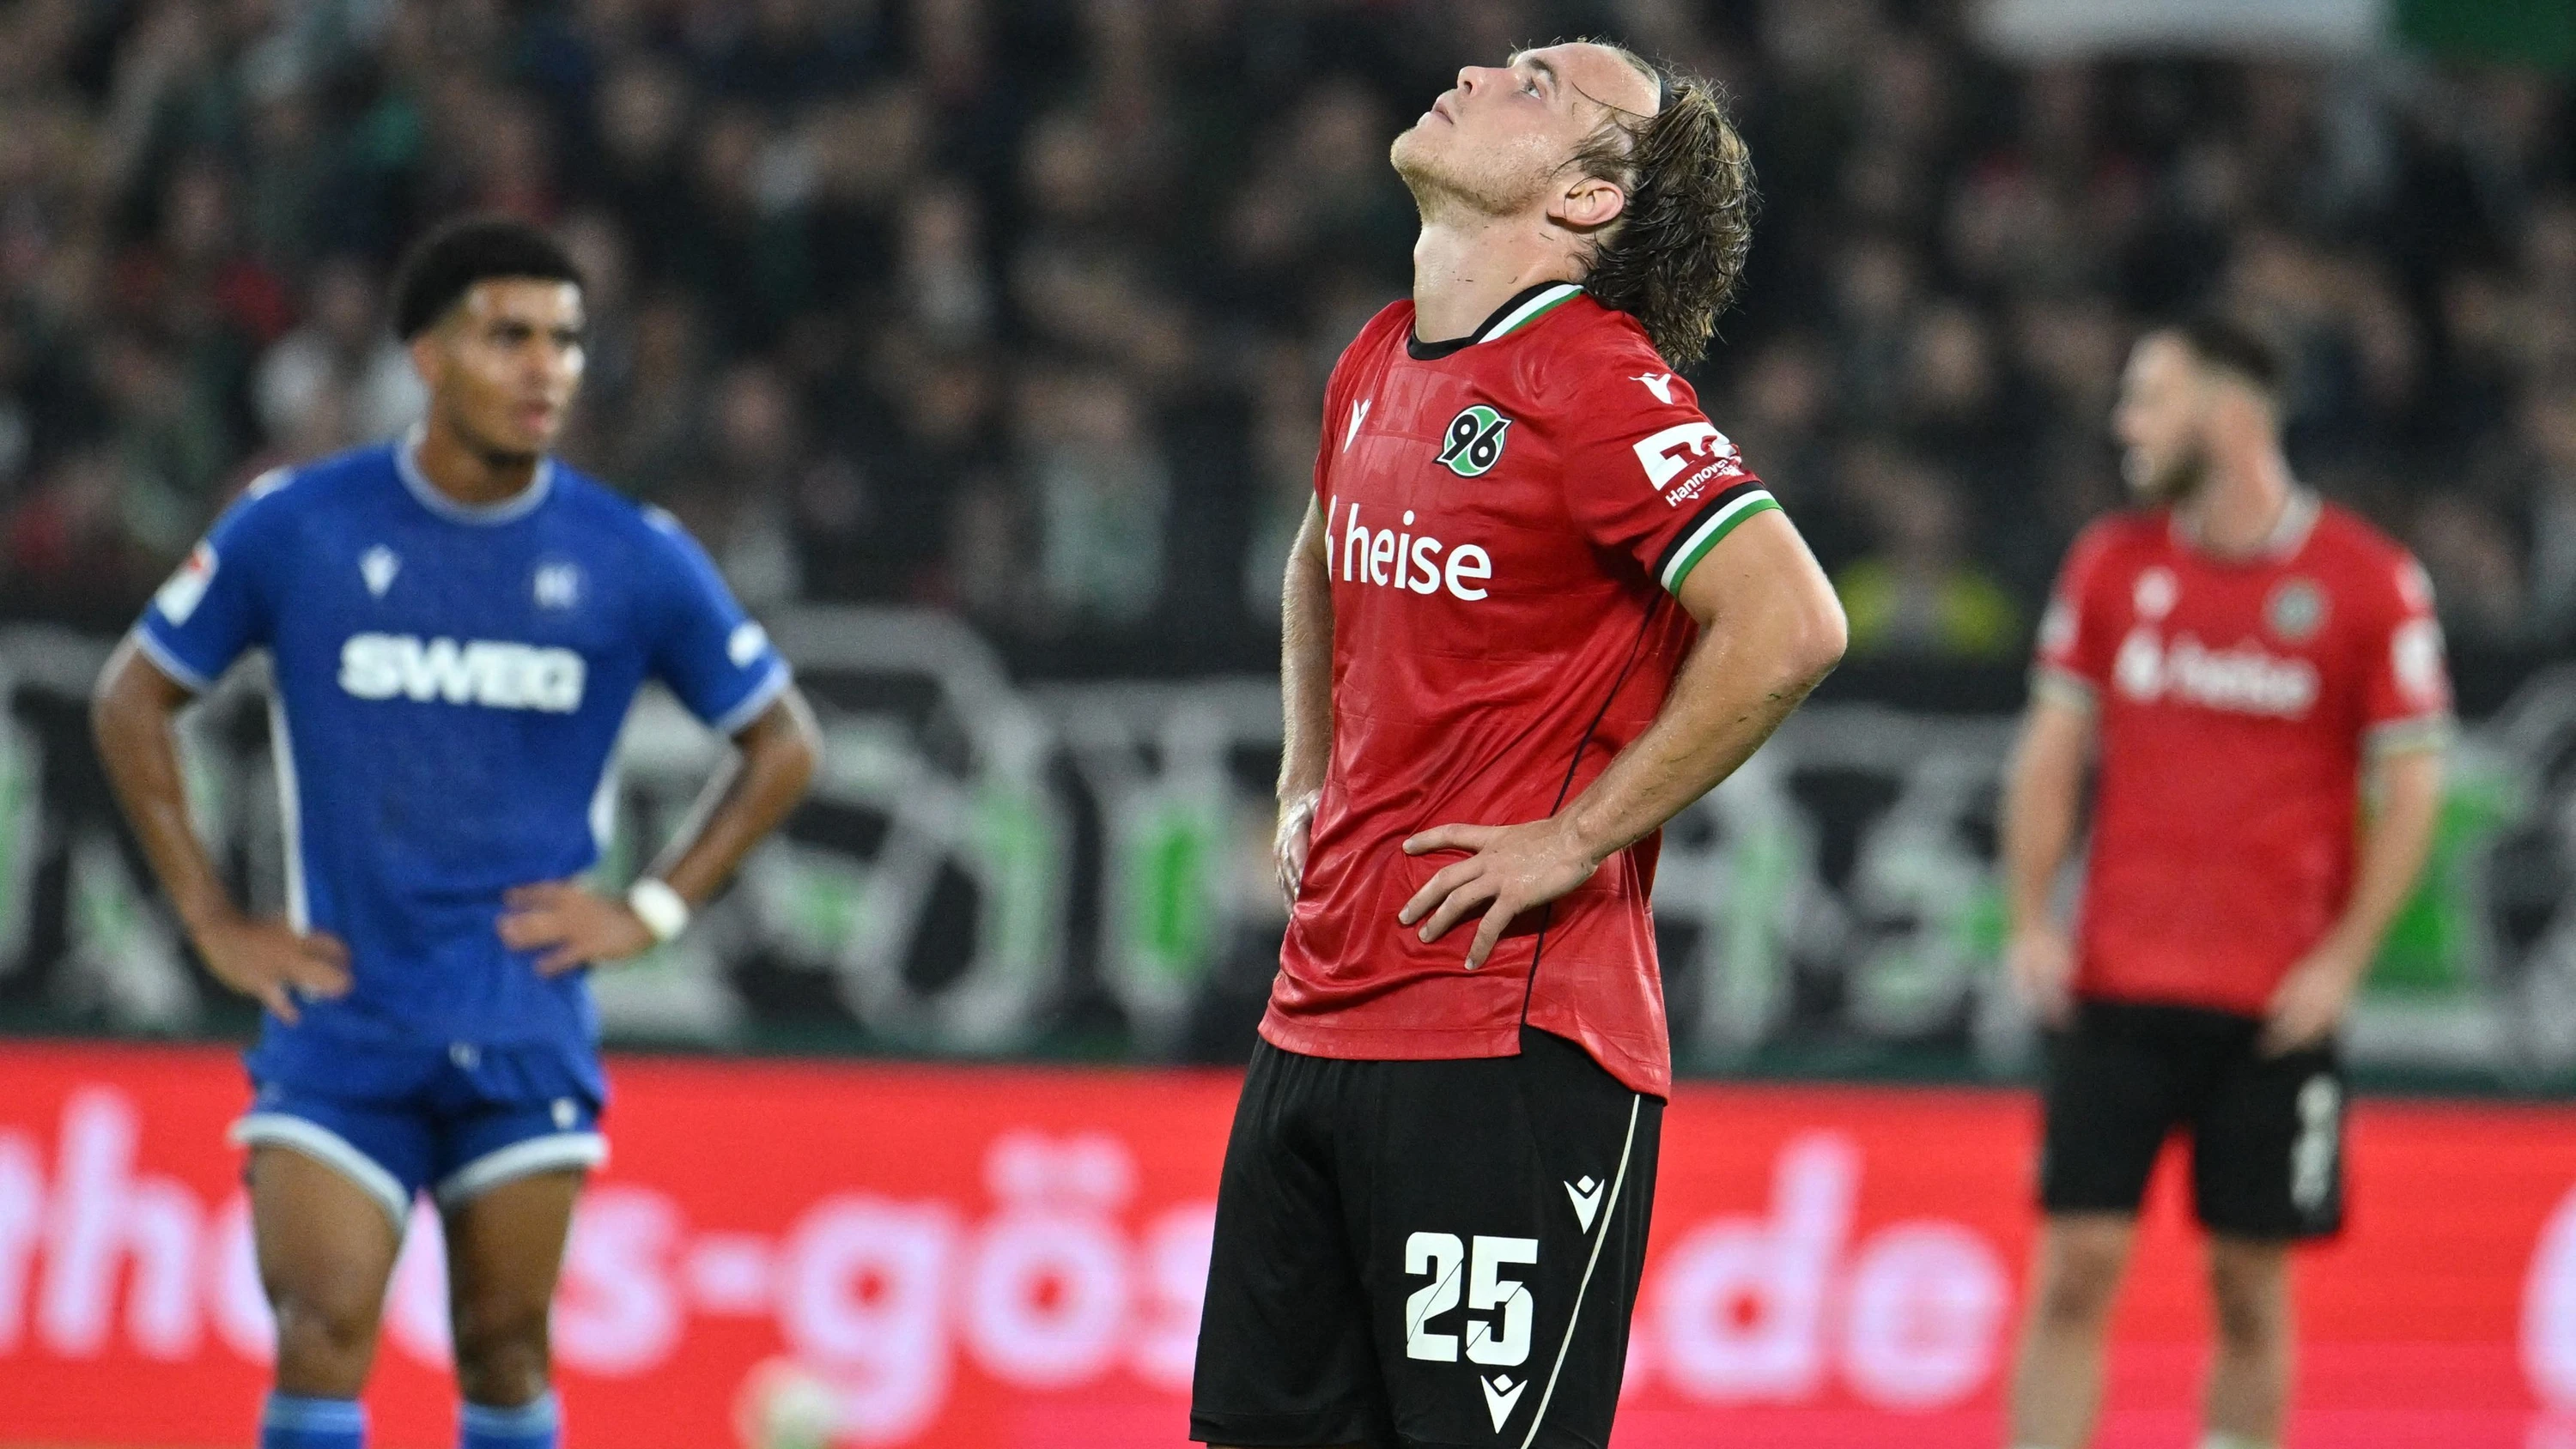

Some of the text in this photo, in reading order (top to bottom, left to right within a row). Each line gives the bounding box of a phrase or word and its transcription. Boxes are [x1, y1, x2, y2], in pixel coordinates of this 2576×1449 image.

[1437, 409, 1510, 472] 96
[1344, 502, 1492, 601] heise
[1406, 1231, 1539, 1367] 25
